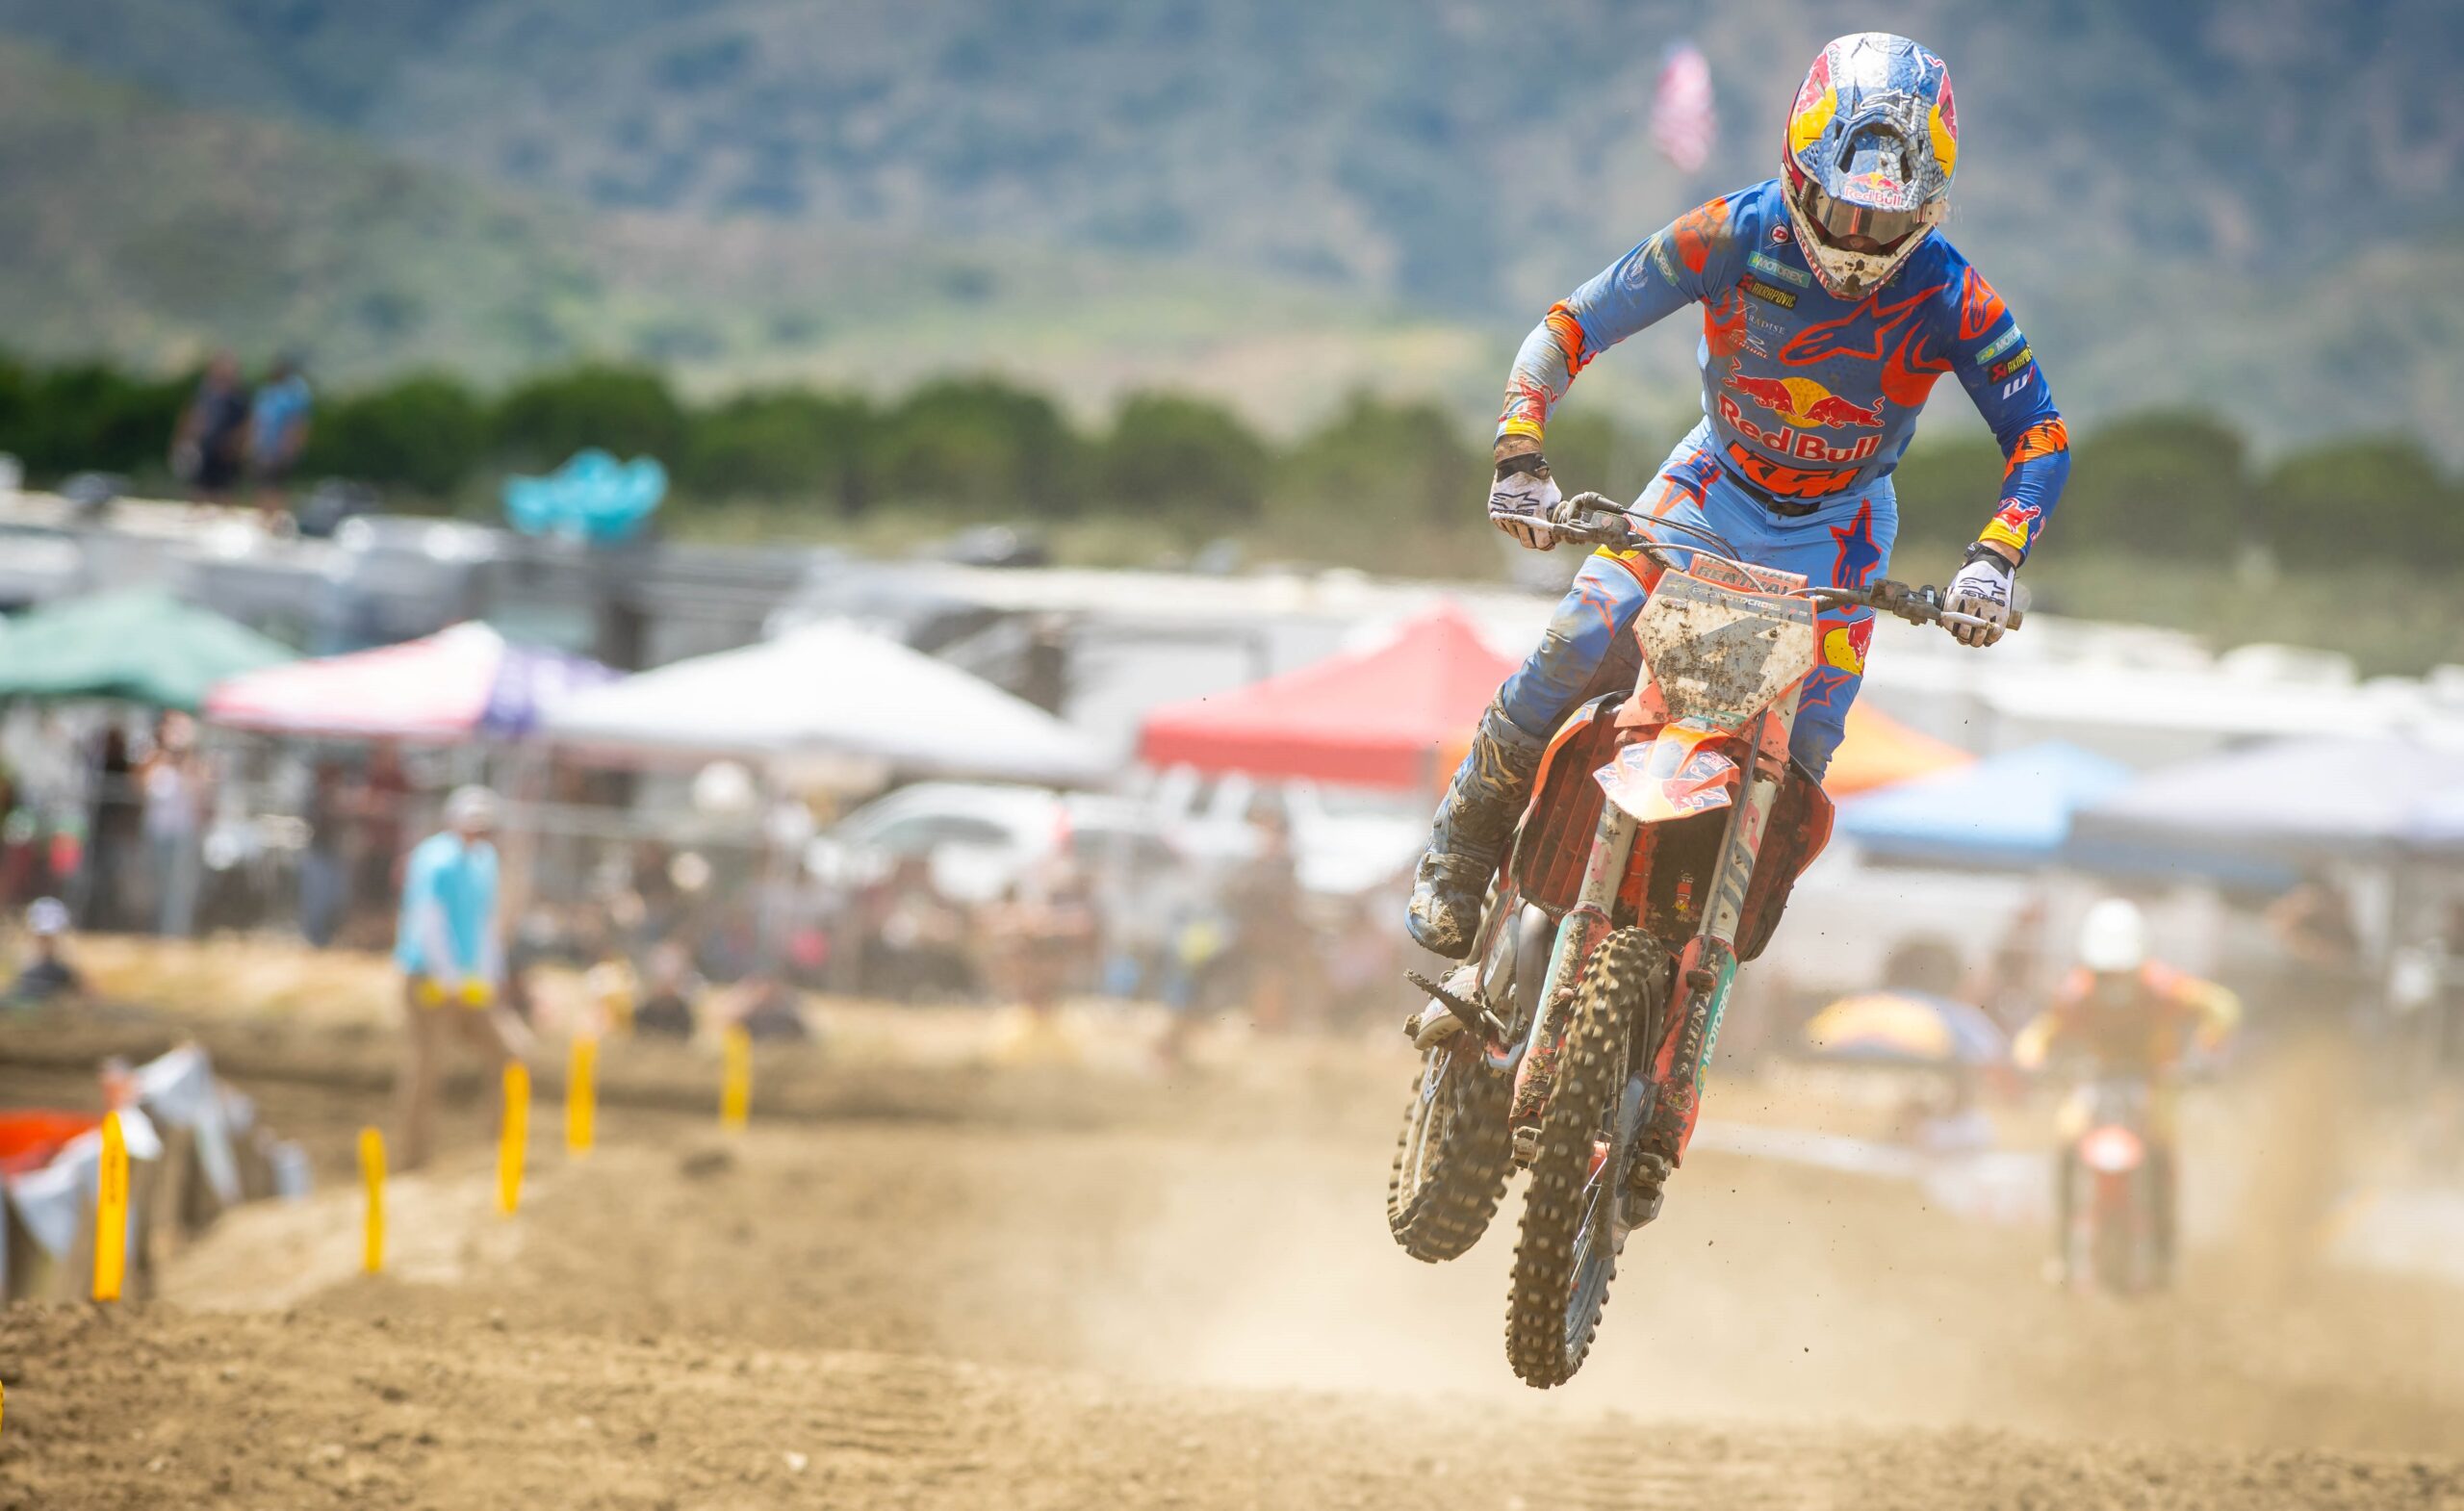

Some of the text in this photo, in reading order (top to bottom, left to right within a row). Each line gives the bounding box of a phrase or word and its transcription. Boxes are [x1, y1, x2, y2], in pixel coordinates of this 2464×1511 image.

[1844, 185, 1902, 207] Red Bull
[1758, 255, 1804, 283] MOTOREX
[1718, 390, 1884, 463] Red Bull
[1726, 440, 1863, 499] KTM
[1703, 977, 1732, 1064] MOTOREX
